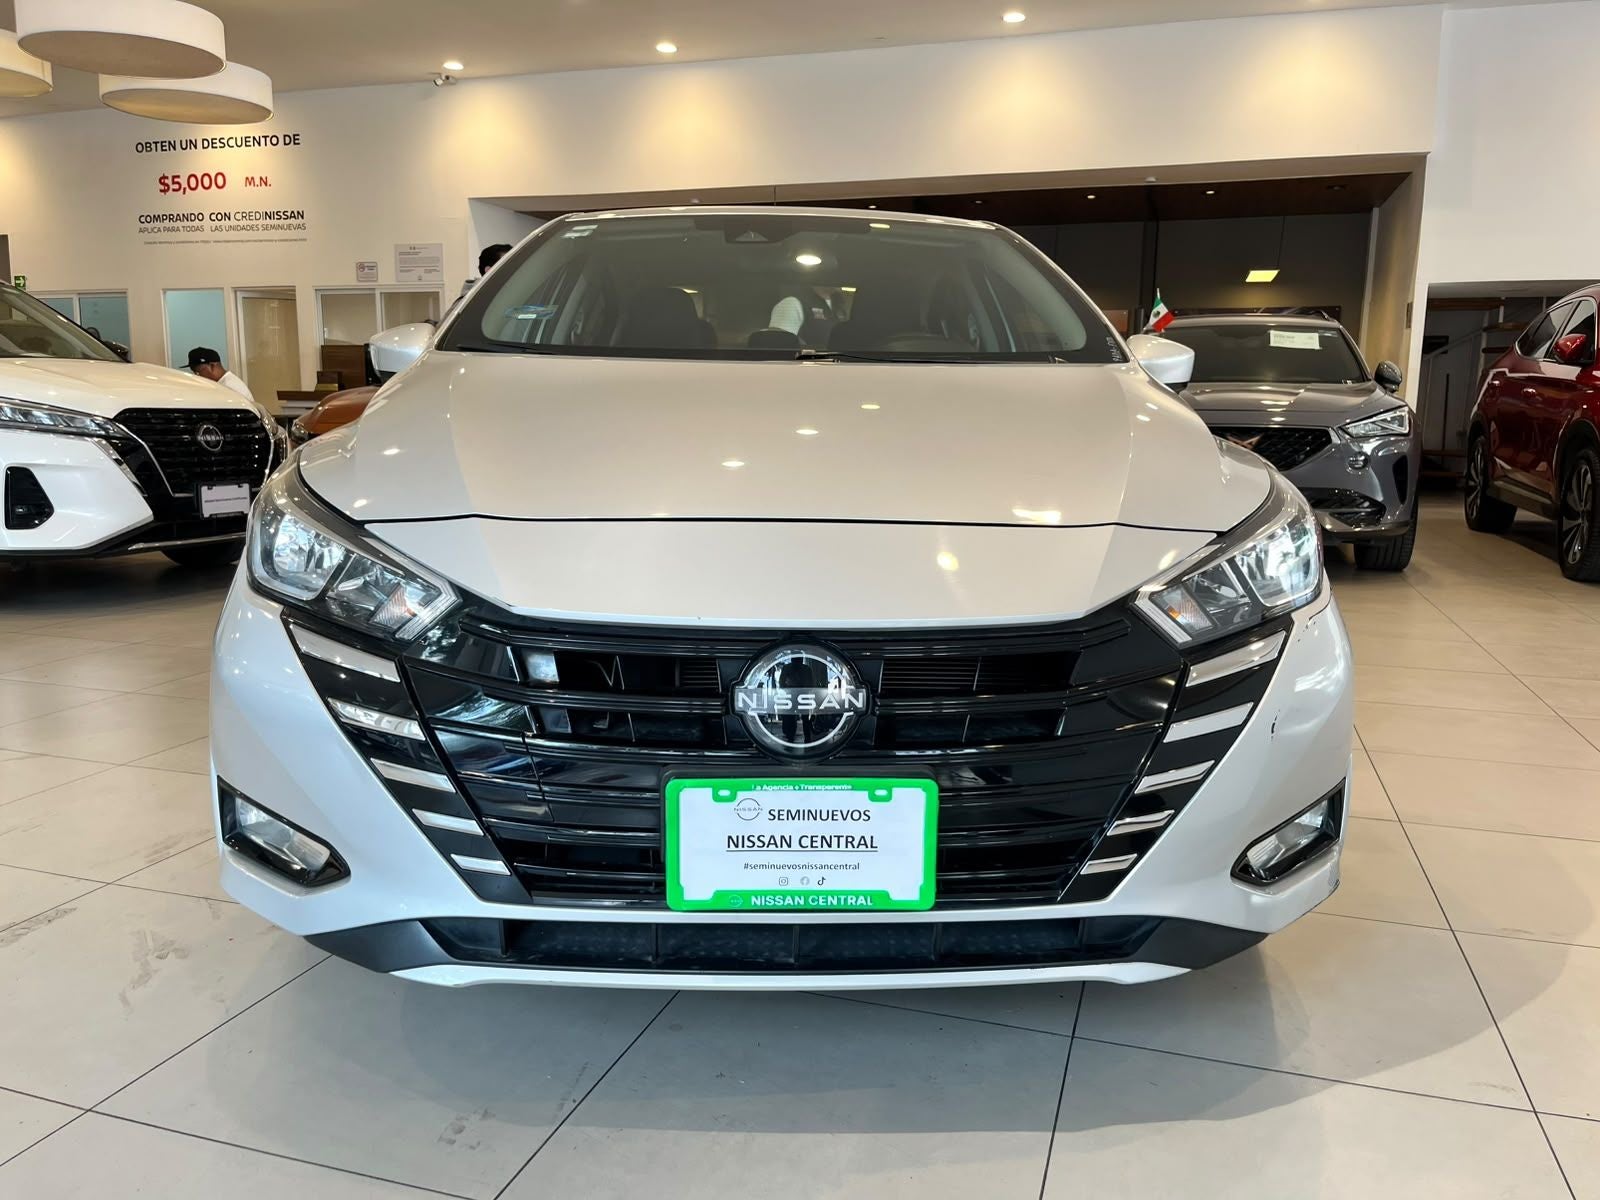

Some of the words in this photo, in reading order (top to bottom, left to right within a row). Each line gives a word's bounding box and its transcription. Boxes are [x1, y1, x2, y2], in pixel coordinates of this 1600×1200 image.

[135, 140, 177, 153] OBTEN
[180, 138, 198, 151] UN
[201, 134, 280, 150] DESCUENTO
[283, 133, 301, 146] DE
[158, 171, 227, 195] $5,000
[244, 176, 272, 188] M.N.
[138, 212, 205, 224] COMPRANDO
[209, 211, 231, 222] CON
[233, 210, 305, 222] CREDINISSAN
[138, 226, 162, 234] APLICA
[163, 225, 180, 233] PARA
[224, 223, 260, 232] UNIDADES
[261, 222, 307, 231] SEMINUEVAS
[737, 692, 864, 710] NISSAN
[768, 808, 871, 822] SEMINUEVOS
[727, 835, 792, 849] NISSAN
[798, 834, 878, 849] CENTRAL
[744, 861, 860, 871] #seminuevosnissancentral
[751, 895, 804, 906] NISSAN
[808, 895, 873, 906] CENTRAL
